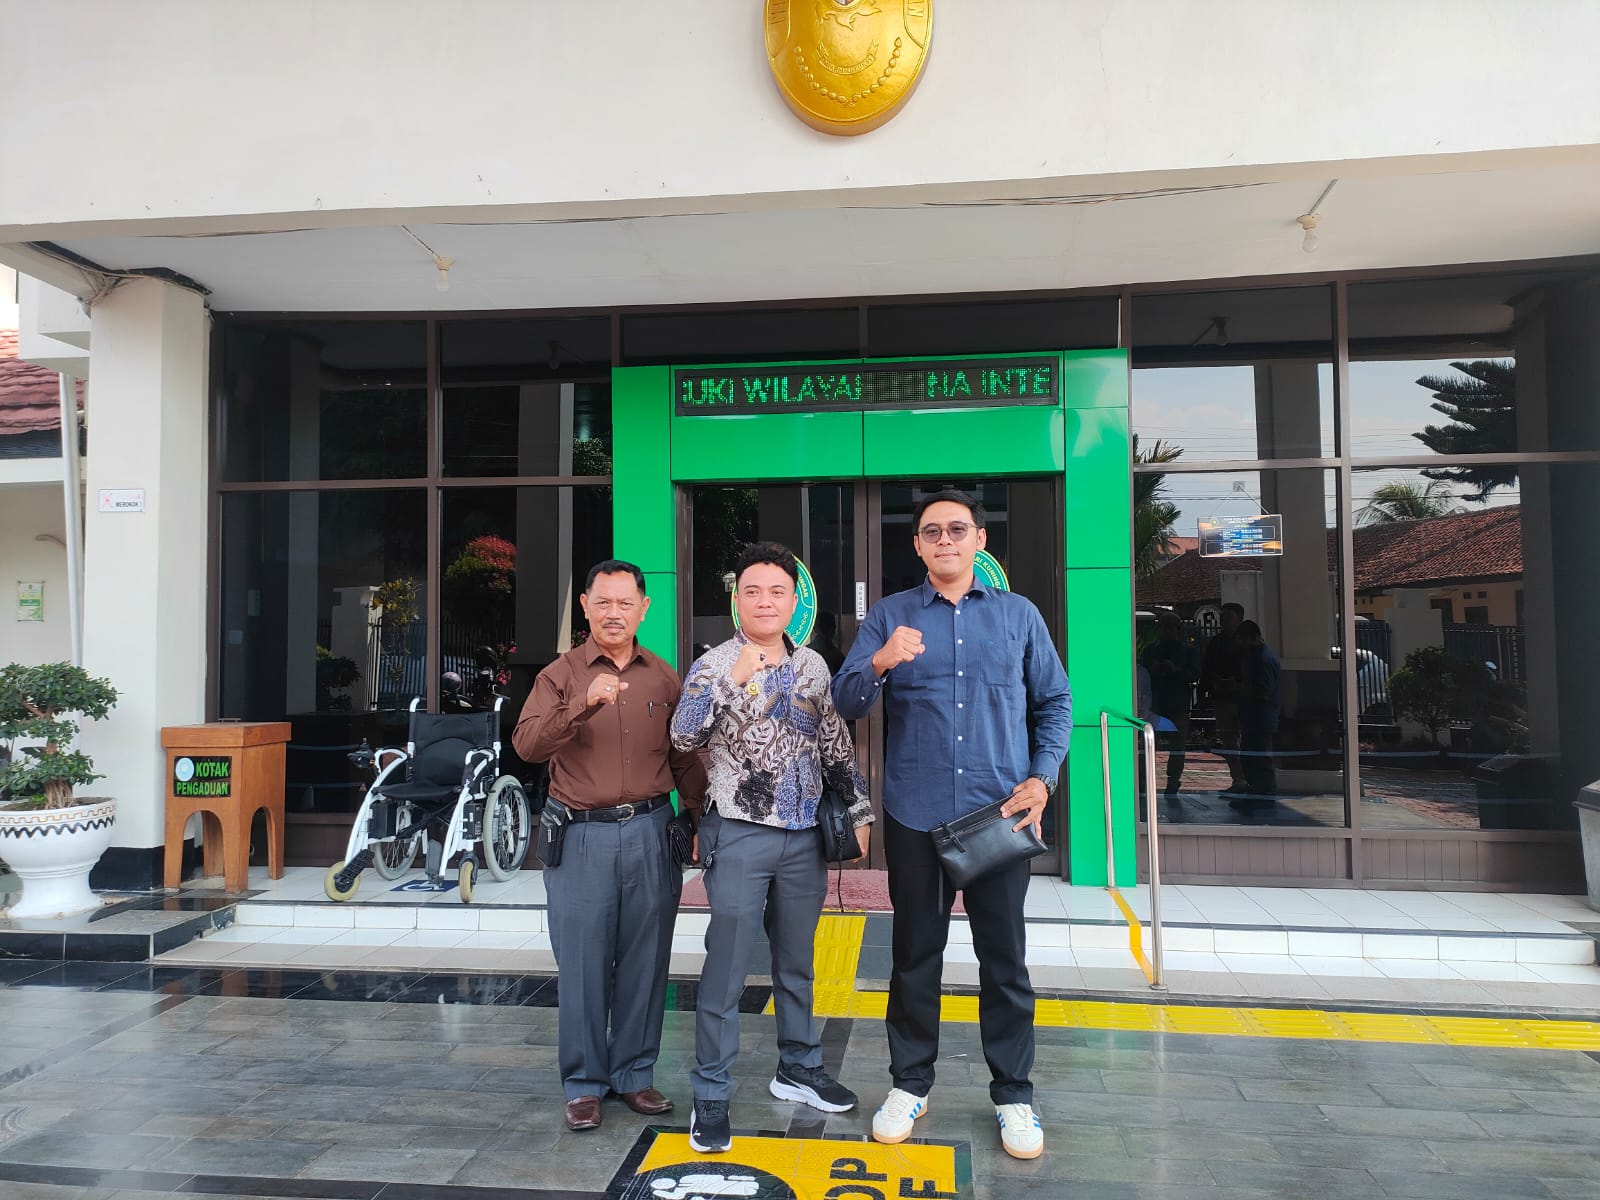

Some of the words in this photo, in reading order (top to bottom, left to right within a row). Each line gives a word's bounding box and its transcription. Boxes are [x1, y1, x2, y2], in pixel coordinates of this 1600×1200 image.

[927, 370, 972, 398] NA
[195, 761, 229, 777] KOTAK
[176, 781, 228, 796] PENGADUAN
